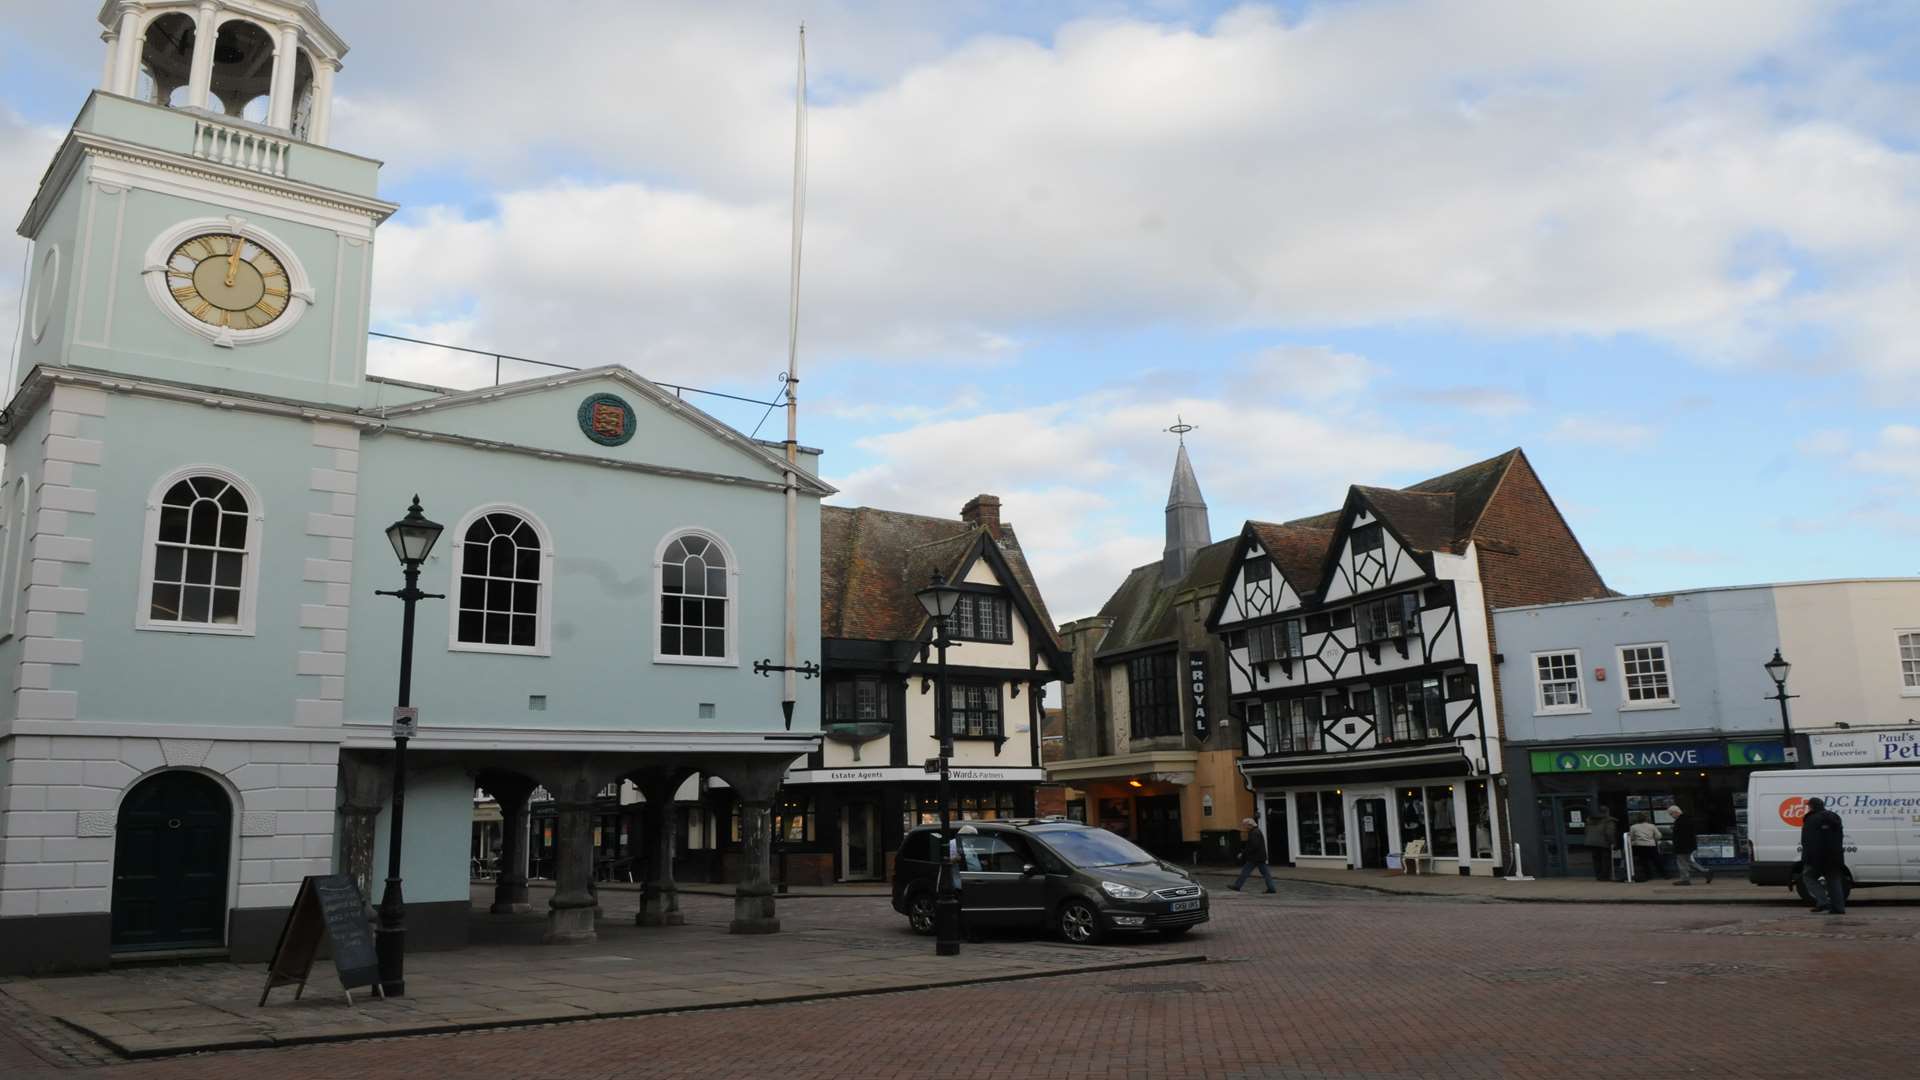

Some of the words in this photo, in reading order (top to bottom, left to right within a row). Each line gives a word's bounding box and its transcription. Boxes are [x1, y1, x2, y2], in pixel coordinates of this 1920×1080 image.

[1192, 670, 1206, 730] ROYAL
[1878, 733, 1915, 742] Paul's
[1582, 753, 1636, 767] YOUR
[1641, 750, 1697, 765] MOVE
[1824, 796, 1849, 807] DC
